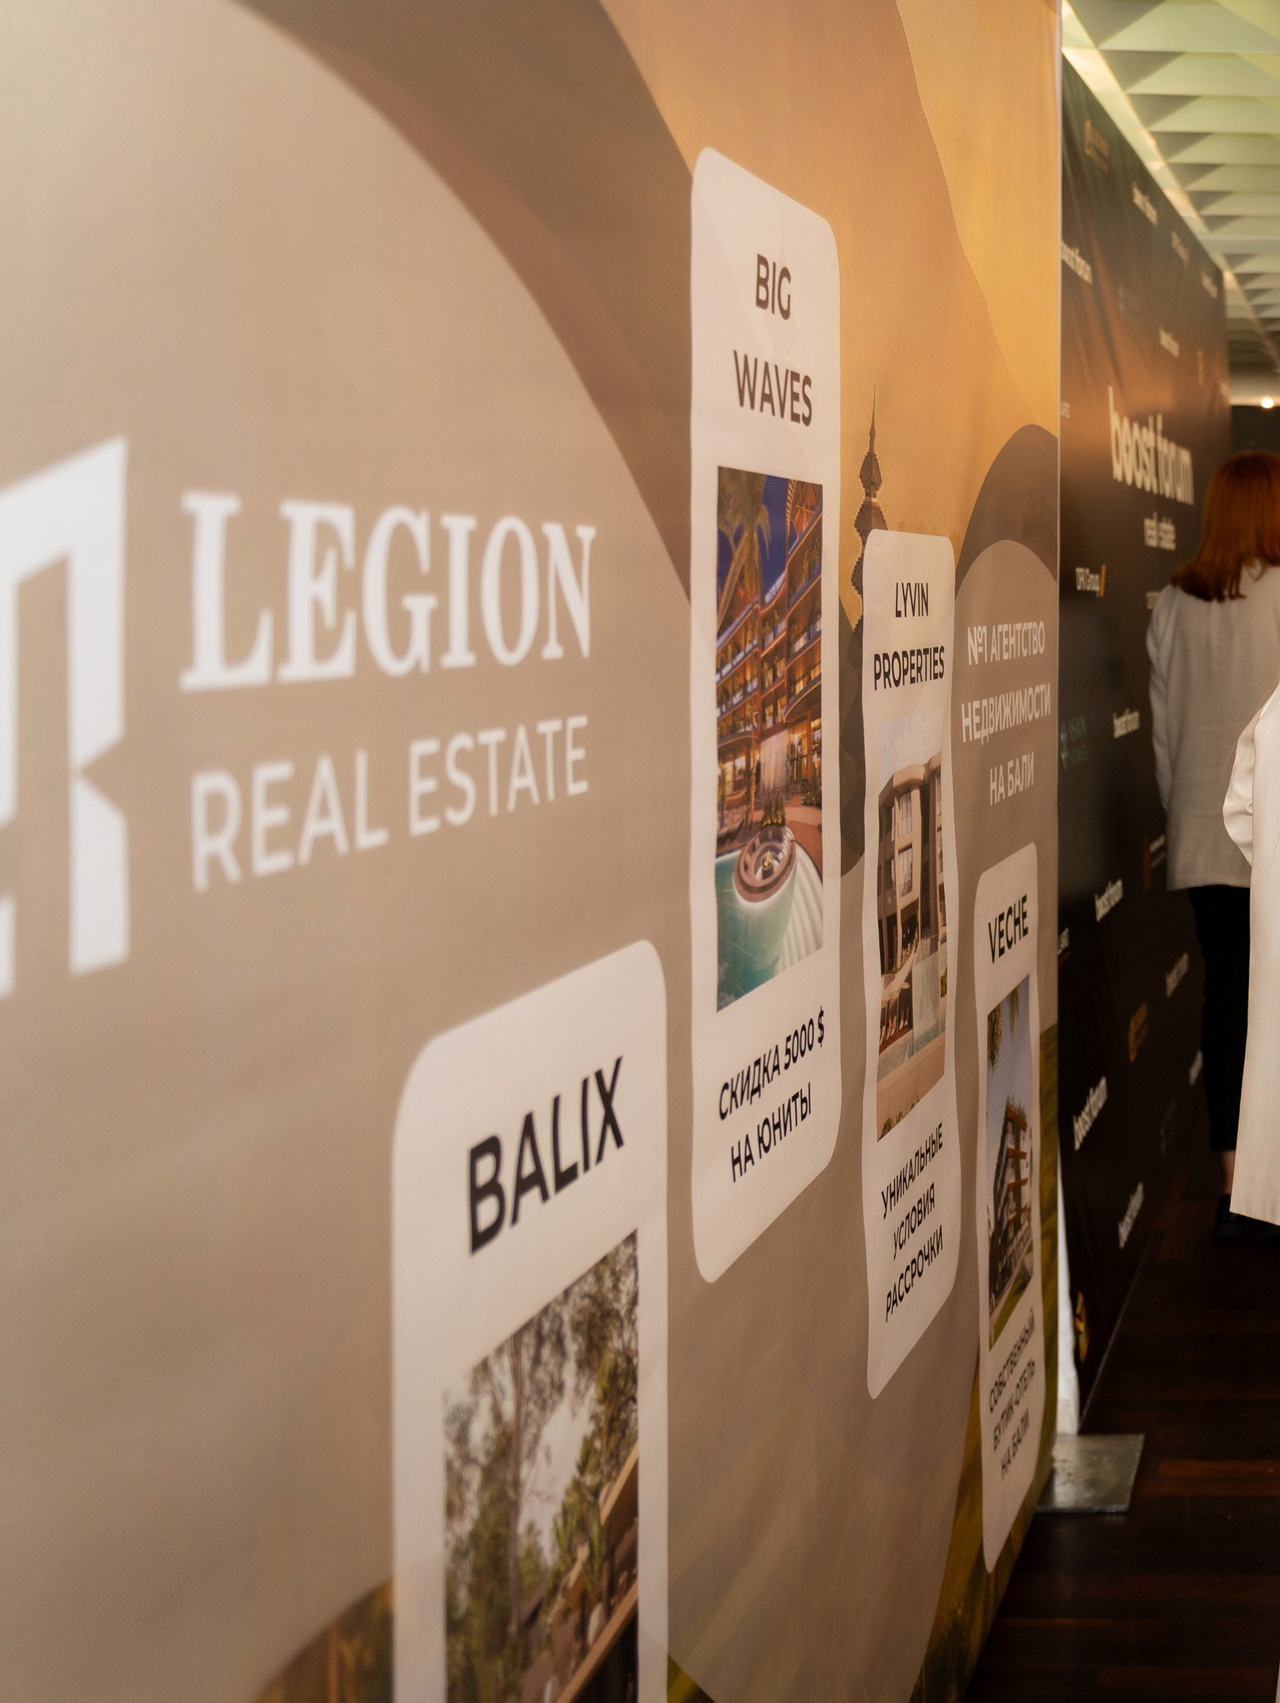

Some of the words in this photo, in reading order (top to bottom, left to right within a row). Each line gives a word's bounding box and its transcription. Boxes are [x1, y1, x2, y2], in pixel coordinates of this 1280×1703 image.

[755, 253, 792, 321] BIG
[732, 349, 812, 427] WAVES
[1108, 385, 1157, 494] boost
[1155, 413, 1194, 505] forum
[178, 490, 597, 693] LEGION
[895, 582, 929, 618] LYVIN
[874, 645, 945, 691] PROPERTIES
[967, 625, 988, 666] №1
[990, 620, 1045, 662] АГЕНТСТВО
[961, 683, 1050, 745] НЕДВИЖИМОСТИ
[191, 749, 390, 893] REAL
[409, 715, 590, 837] ESTATE
[989, 764, 1005, 806] НА
[1007, 751, 1034, 797] БАЛИ
[988, 894, 1029, 964] VECHE
[718, 1044, 781, 1121] СКИДКА
[784, 1017, 815, 1071] 5000
[817, 1005, 825, 1048] $
[468, 1055, 625, 1257] BALIX
[730, 1133, 755, 1183] НА
[757, 1081, 812, 1160] ЮНИТЫ
[881, 1121, 943, 1220] УНИКАЛЬНЫЕ
[893, 1181, 936, 1261] УСЛОВИЯ
[885, 1224, 943, 1324] РАССРОЧКИ
[1001, 1444, 1012, 1481] НА
